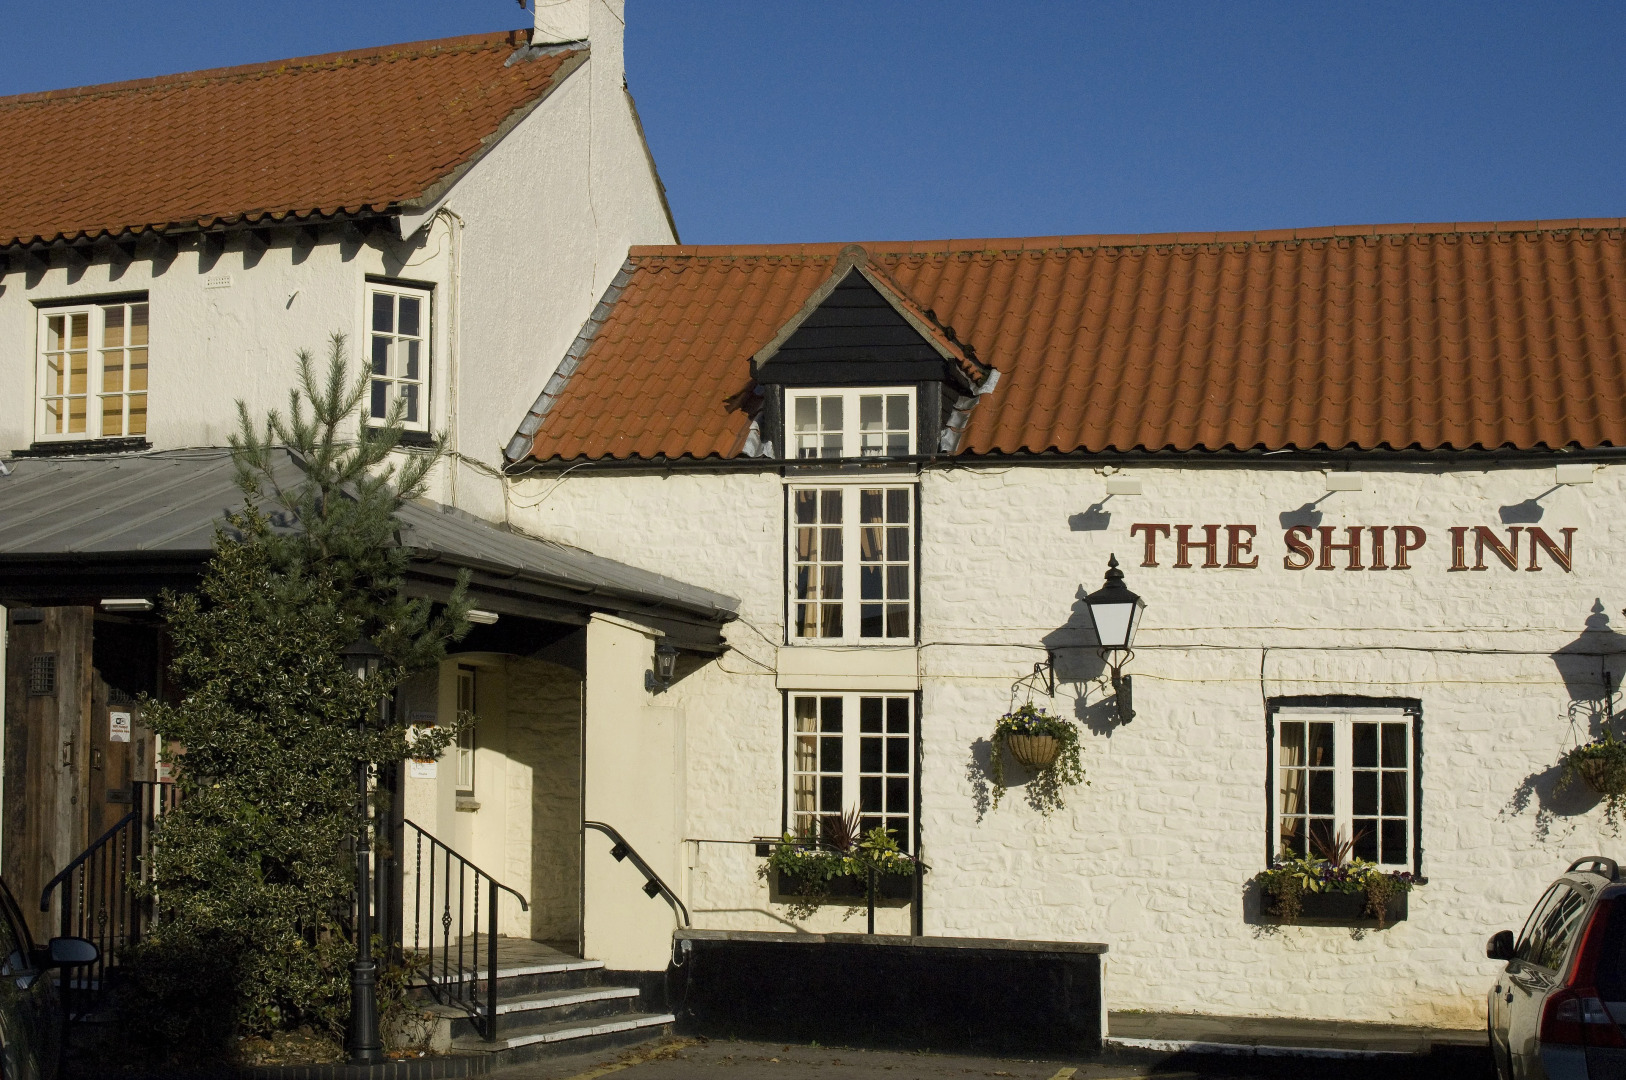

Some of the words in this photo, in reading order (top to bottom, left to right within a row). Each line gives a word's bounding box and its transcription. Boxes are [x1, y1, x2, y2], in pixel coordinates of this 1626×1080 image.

[1130, 523, 1259, 569] THE
[1283, 525, 1427, 571] SHIP
[1447, 526, 1578, 573] INN
